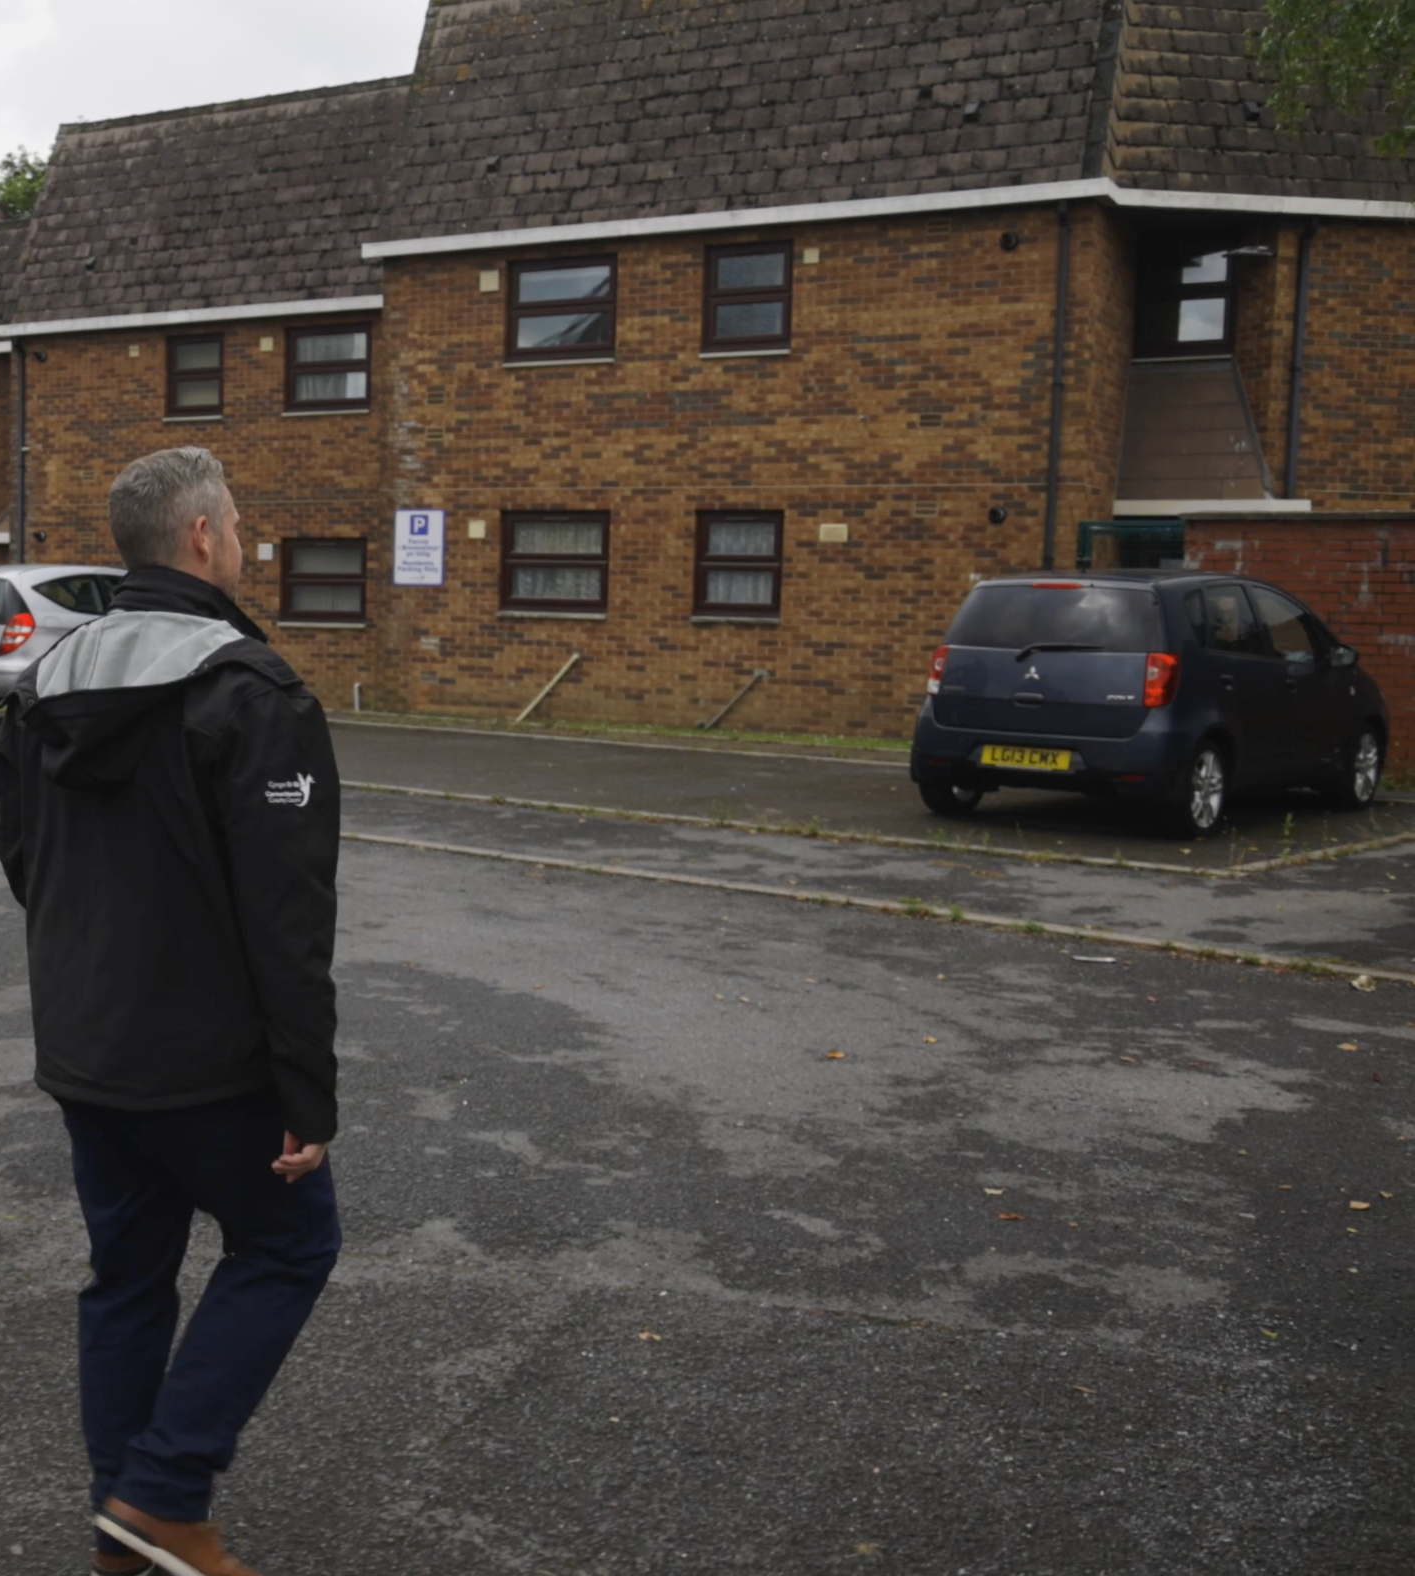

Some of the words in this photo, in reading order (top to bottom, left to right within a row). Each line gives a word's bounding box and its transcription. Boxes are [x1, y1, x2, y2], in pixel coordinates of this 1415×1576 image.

[413, 517, 426, 533] P
[991, 746, 1025, 764] LG13
[1029, 748, 1060, 766] CMX
